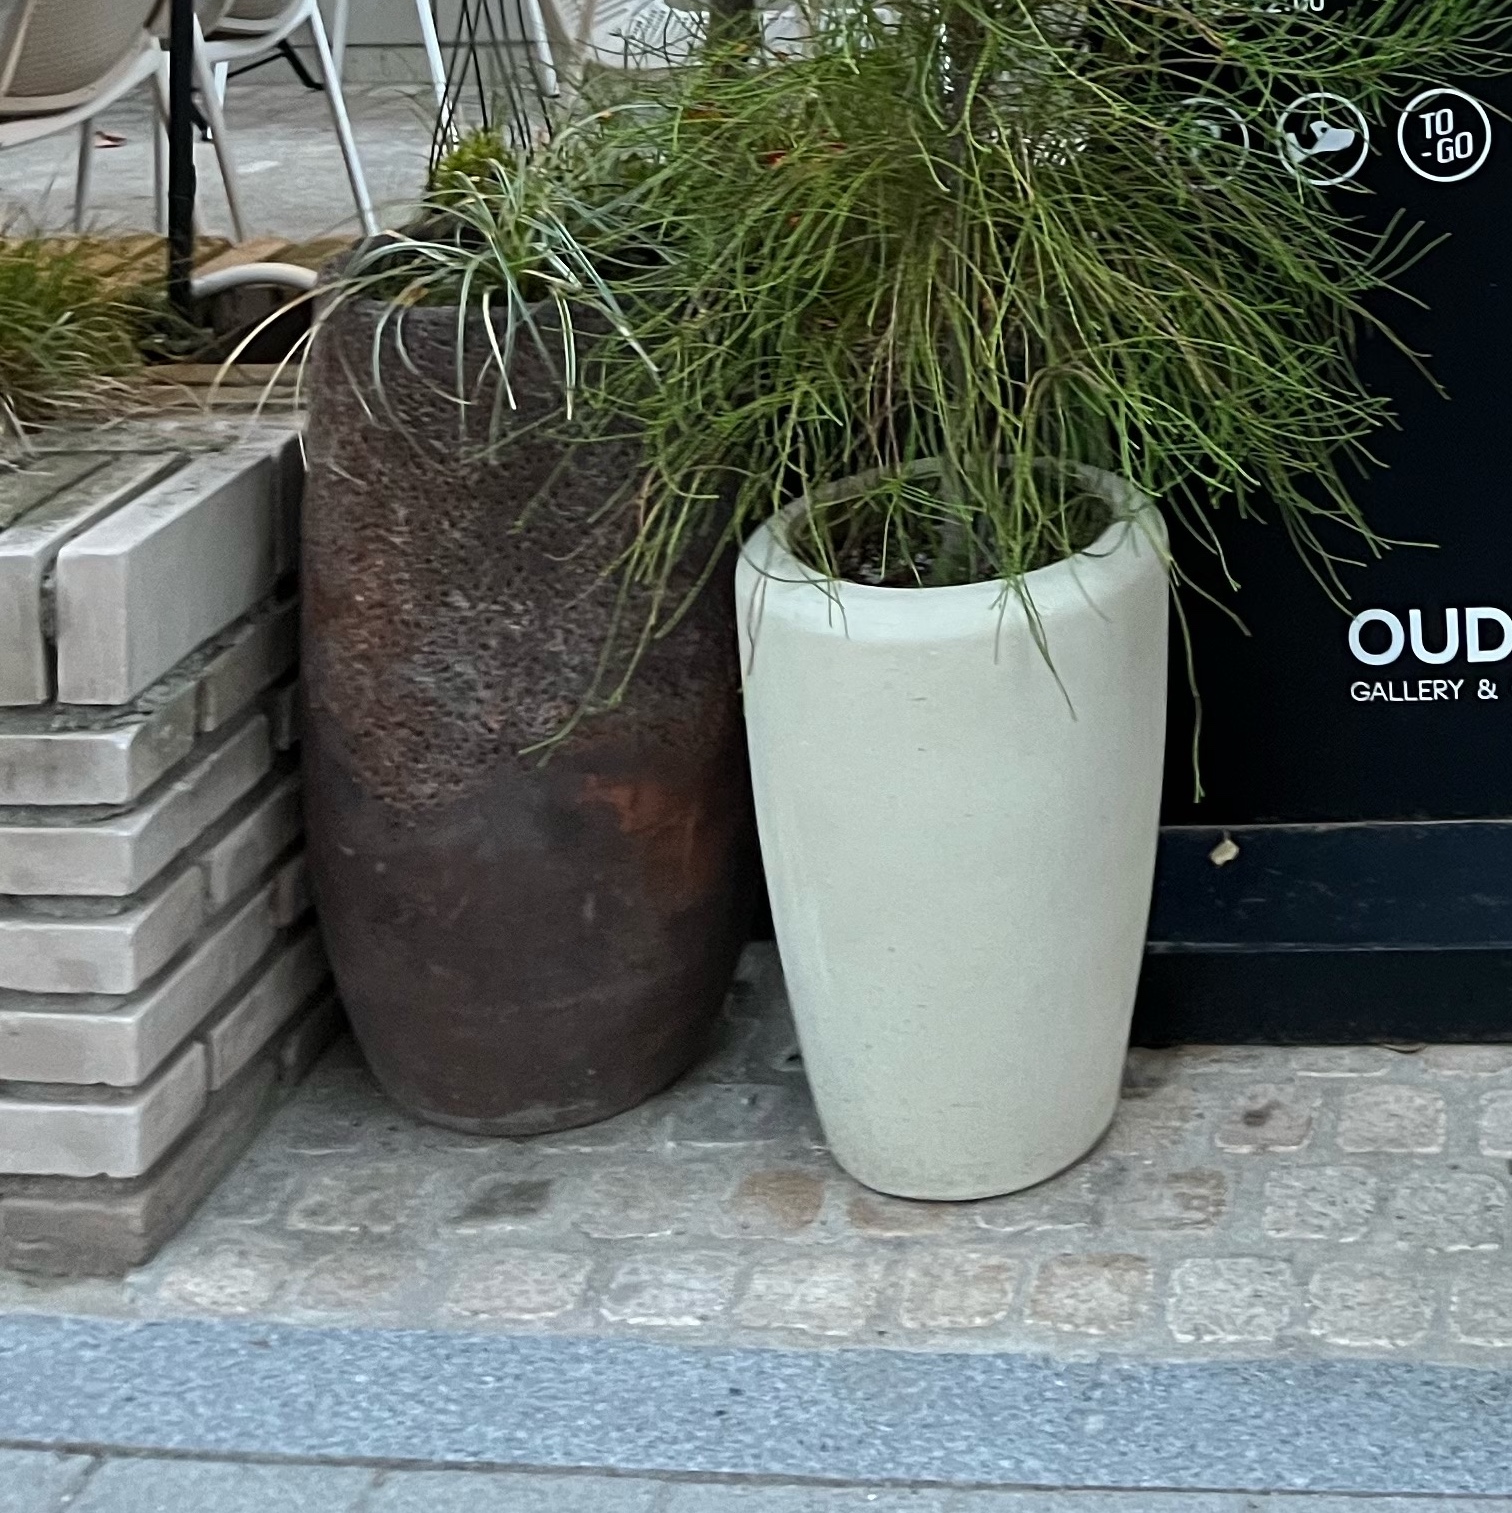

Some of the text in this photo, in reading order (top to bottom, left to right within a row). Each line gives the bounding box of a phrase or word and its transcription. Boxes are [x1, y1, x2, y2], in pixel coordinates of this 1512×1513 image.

[1419, 108, 1454, 139] TO
[1350, 679, 1464, 702] GALLERY
[1477, 678, 1498, 700] &
